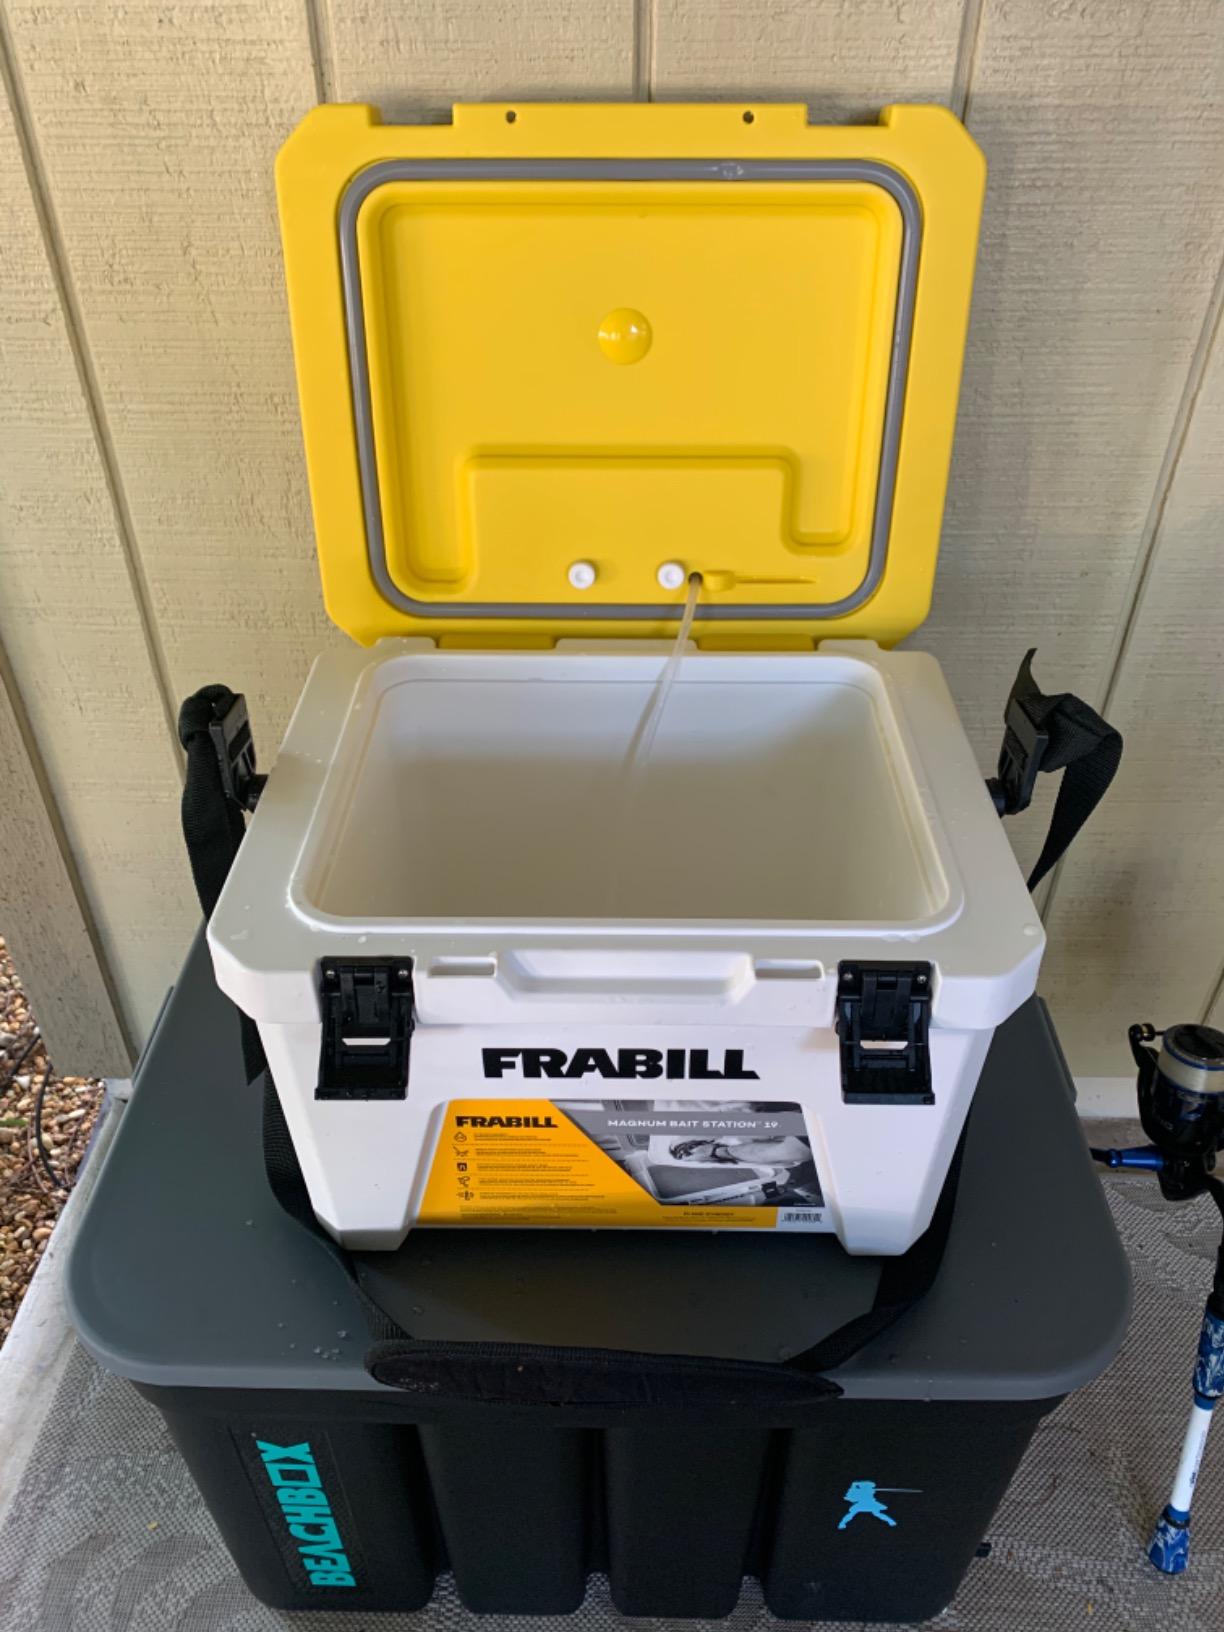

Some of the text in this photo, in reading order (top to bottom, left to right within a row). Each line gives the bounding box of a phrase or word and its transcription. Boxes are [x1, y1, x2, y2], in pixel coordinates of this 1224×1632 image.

[482, 1048, 761, 1079] FRABILL
[455, 1115, 558, 1128] FRABILL
[607, 1119, 667, 1128] MAGNUM
[669, 1120, 700, 1128] BAIT
[764, 1121, 779, 1129] 19
[256, 1440, 357, 1587] BEACHBOX
